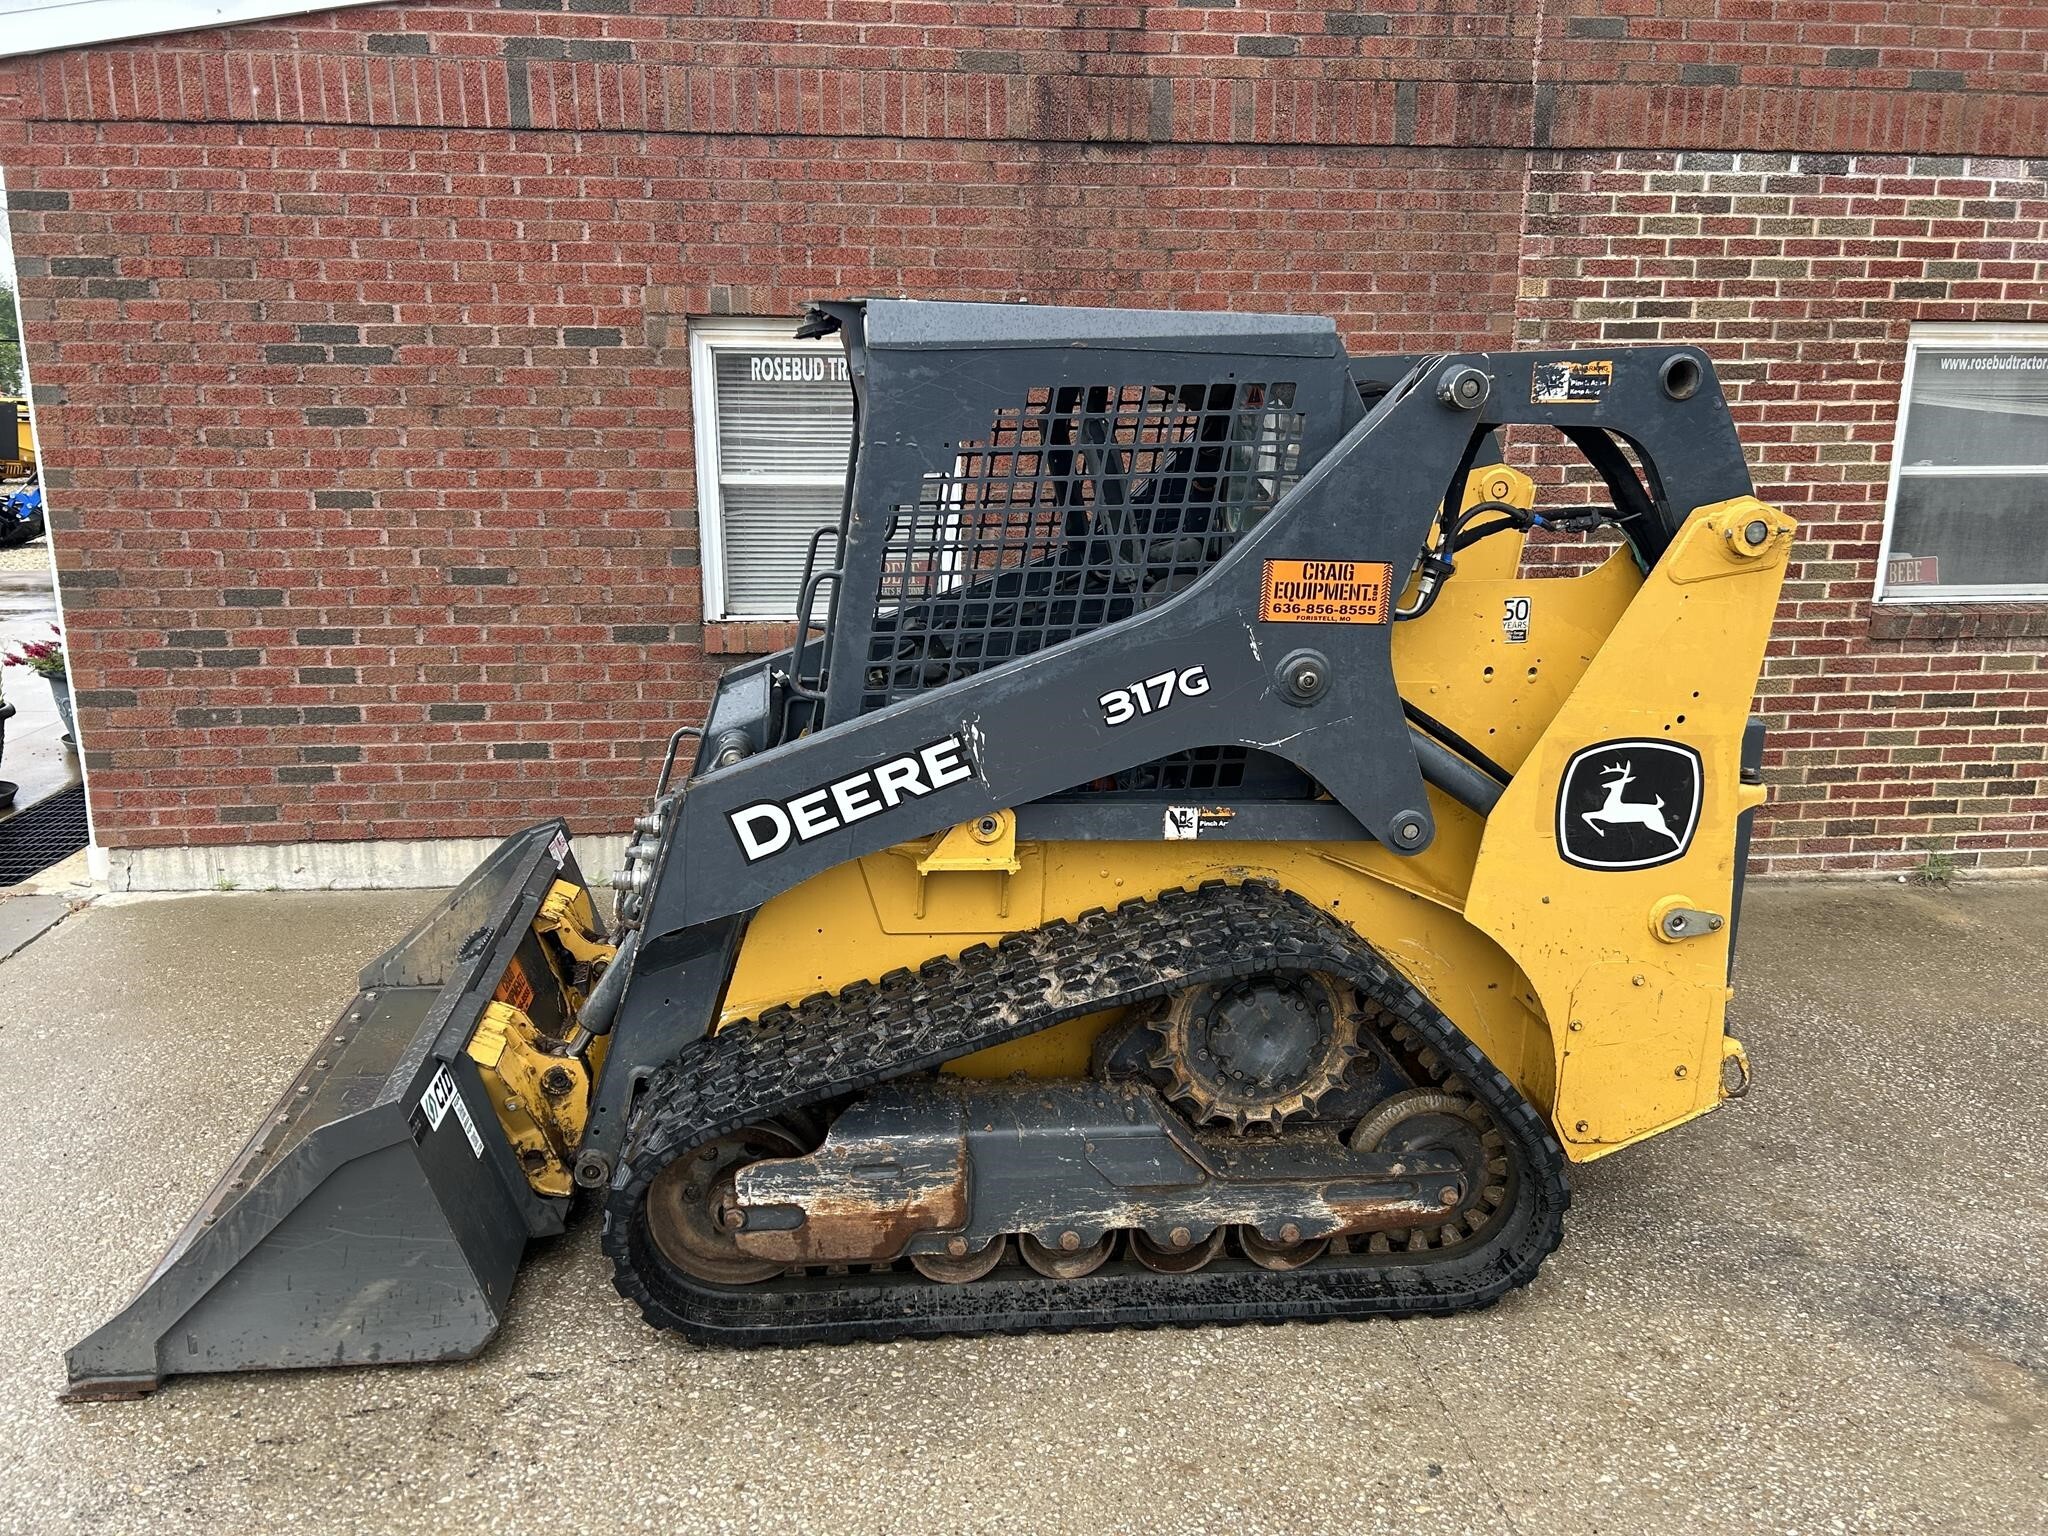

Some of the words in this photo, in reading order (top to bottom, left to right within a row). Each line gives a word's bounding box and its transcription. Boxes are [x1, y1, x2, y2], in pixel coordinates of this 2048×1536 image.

[751, 357, 824, 381] ROSEBUD
[828, 357, 850, 381] TR
[1302, 562, 1355, 581] CRAIG
[1272, 603, 1376, 615] 636-856-8555
[1502, 599, 1529, 621] 50
[1502, 621, 1527, 629] YEARS
[1099, 666, 1210, 725] 317G
[730, 736, 972, 862] DEERE
[433, 1067, 454, 1110] CID
